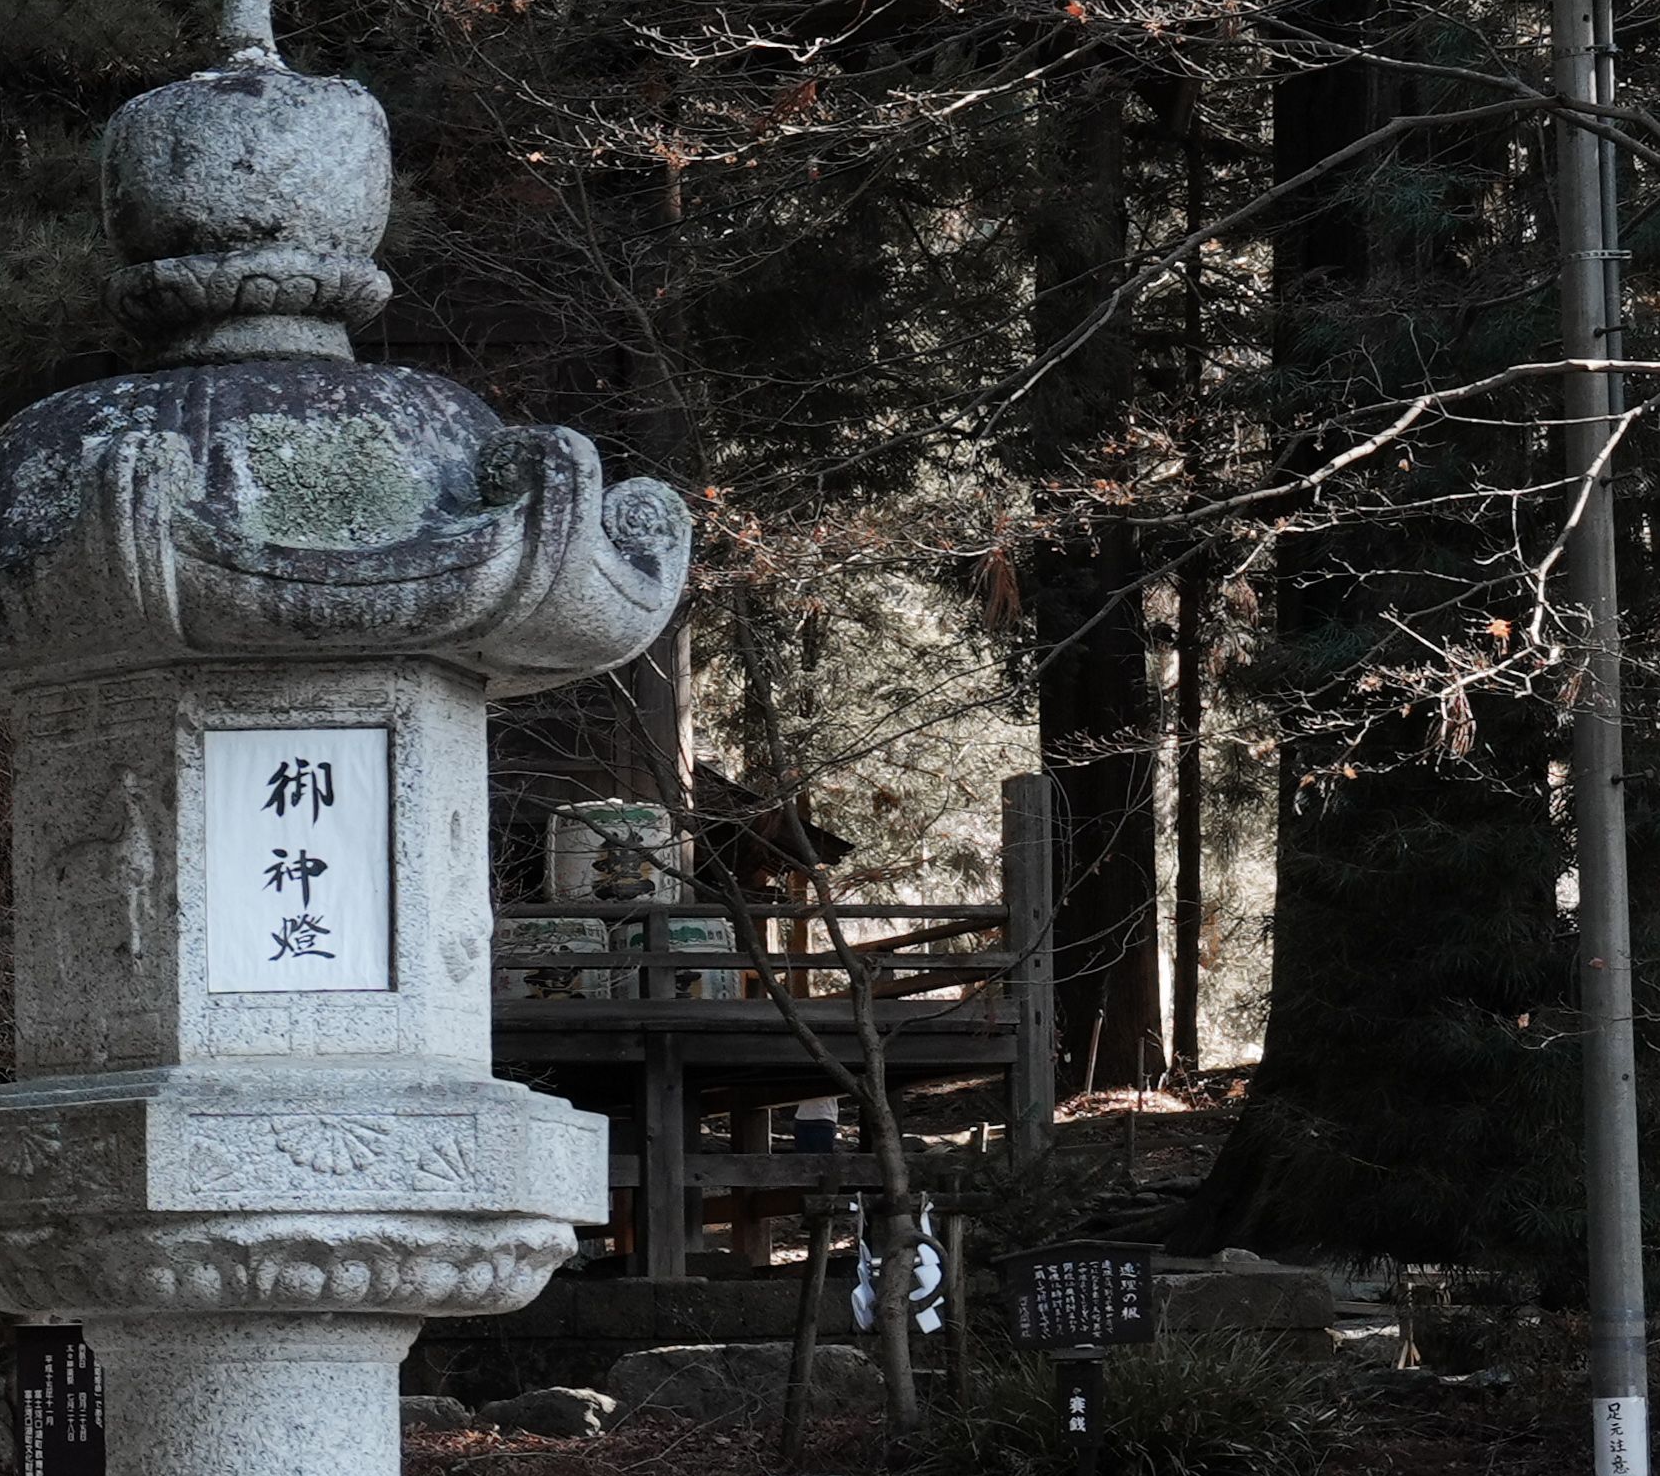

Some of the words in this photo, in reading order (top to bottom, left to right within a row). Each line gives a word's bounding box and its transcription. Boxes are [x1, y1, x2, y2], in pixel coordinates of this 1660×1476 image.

[259, 756, 337, 963] 御神燈
[1605, 1402, 1630, 1475] 足元注意
